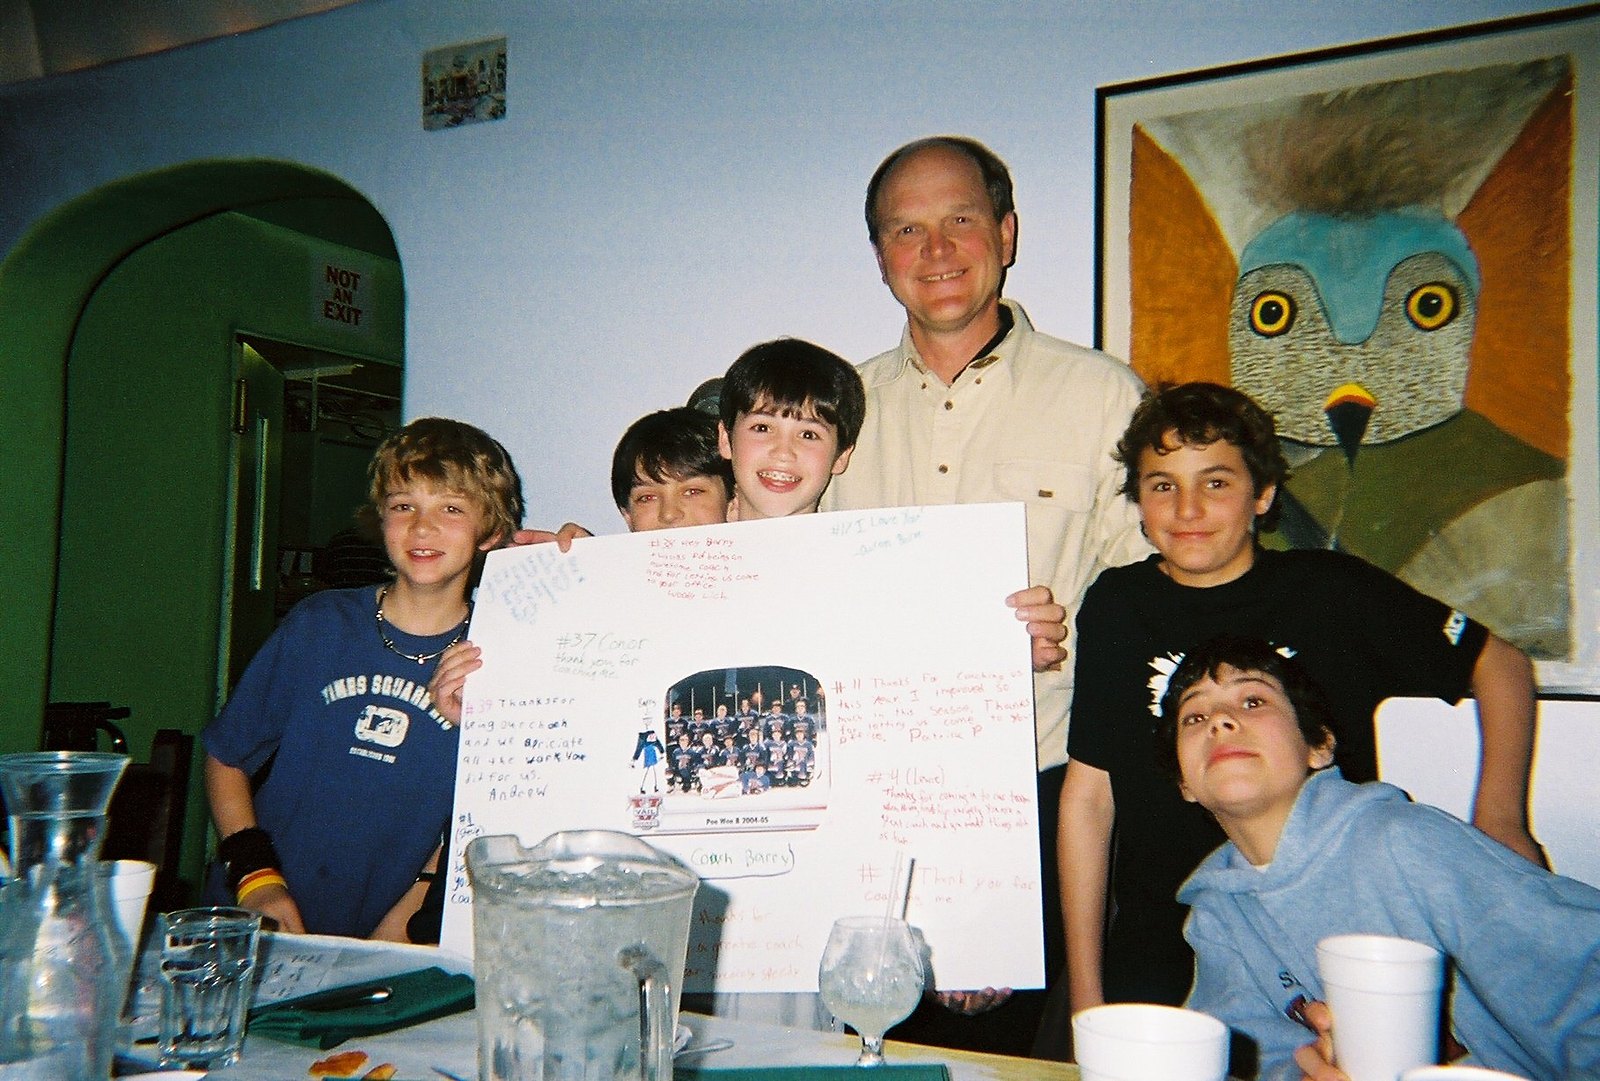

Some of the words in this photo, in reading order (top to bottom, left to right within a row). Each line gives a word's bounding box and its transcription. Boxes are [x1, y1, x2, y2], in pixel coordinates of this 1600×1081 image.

[327, 265, 361, 291] NOT
[335, 288, 353, 305] AN
[325, 299, 363, 325] EXIT
[556, 633, 597, 650] #37
[598, 632, 649, 652] Conor
[972, 724, 983, 737] P
[489, 784, 549, 802] Andrew
[706, 818, 719, 826] Pee
[742, 816, 769, 824] 2004-05
[690, 848, 733, 867] Coach
[745, 848, 789, 868] Barry
